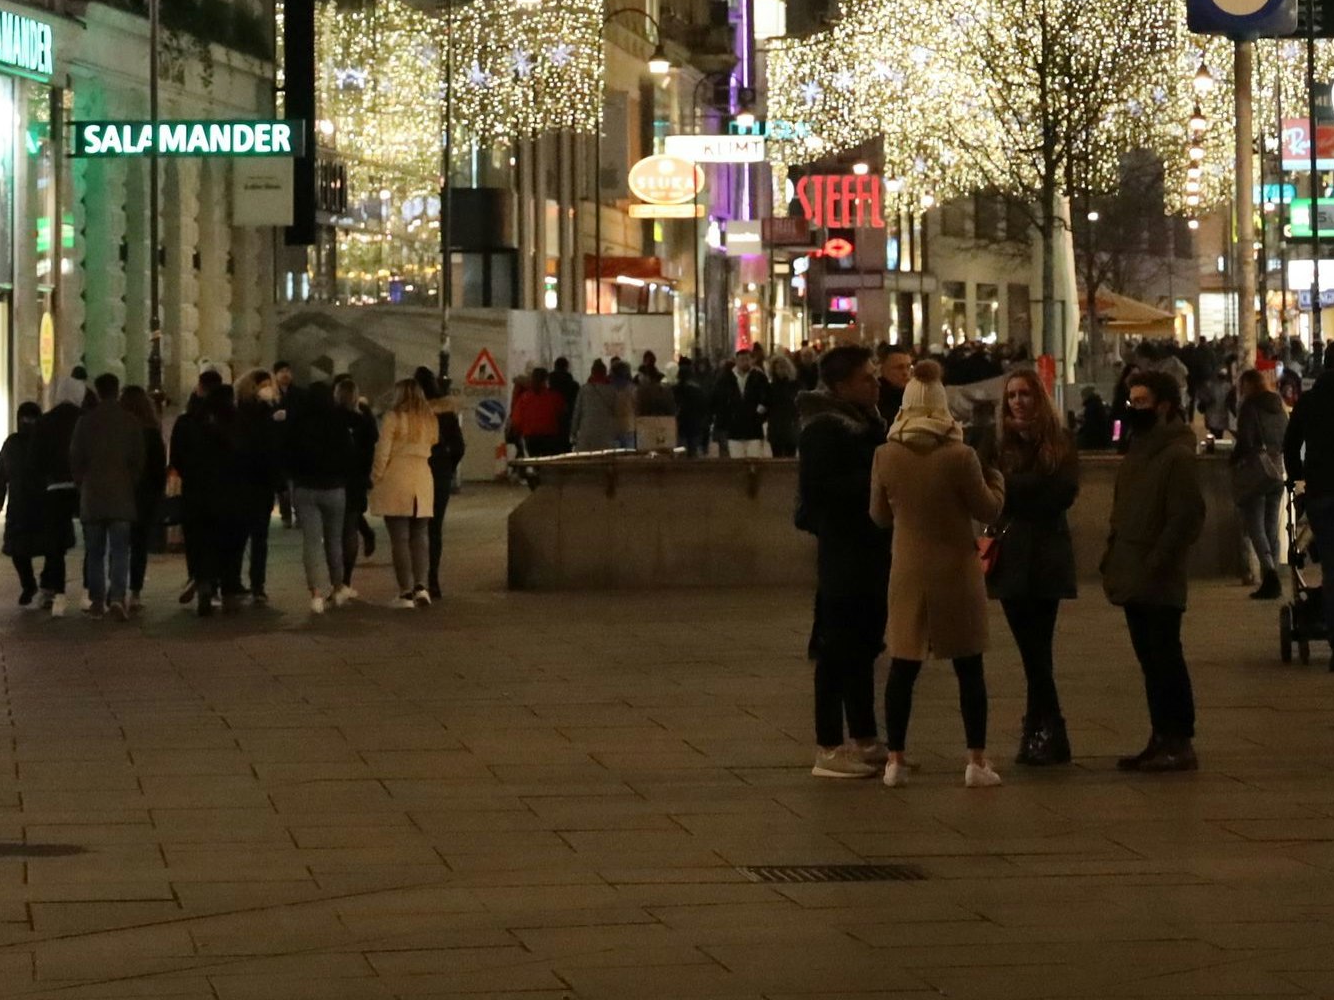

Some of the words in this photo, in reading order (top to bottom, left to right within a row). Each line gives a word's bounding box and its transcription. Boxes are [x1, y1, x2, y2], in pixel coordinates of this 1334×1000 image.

[84, 124, 292, 154] SALAMANDER
[704, 141, 762, 155] KLIMT
[797, 175, 885, 229] STEFFL
